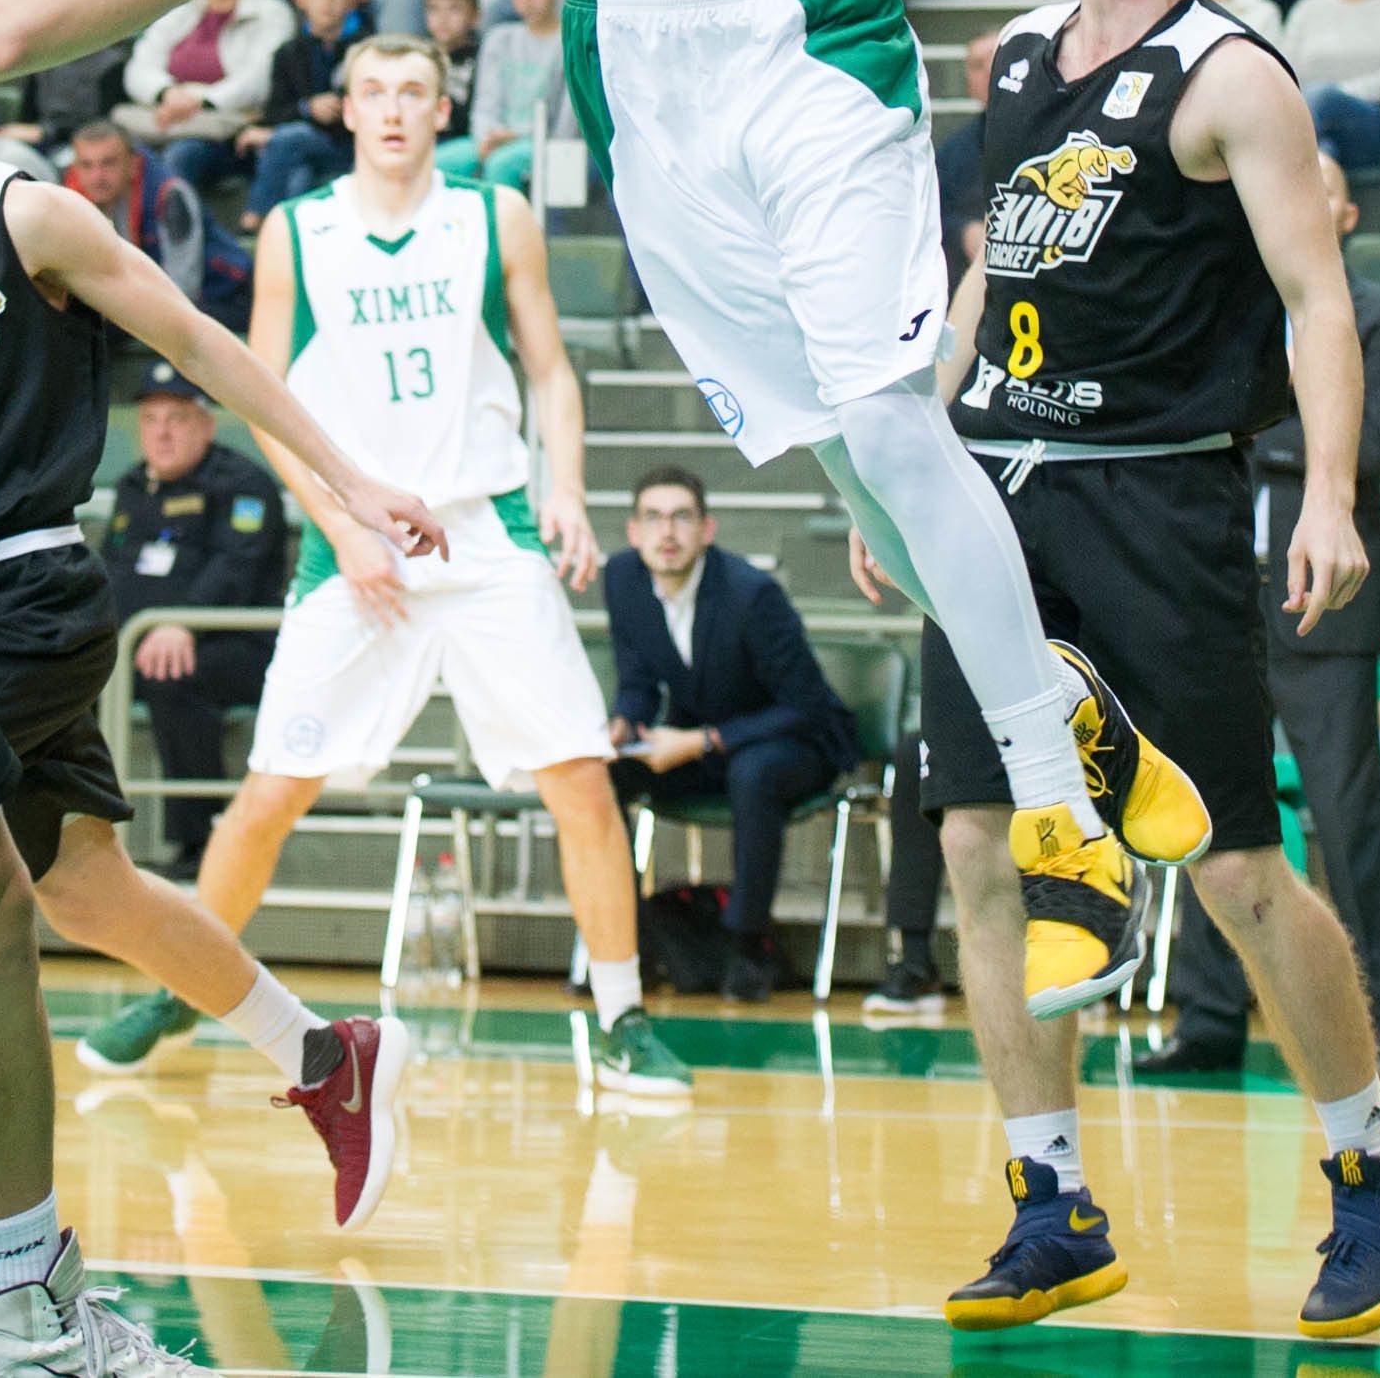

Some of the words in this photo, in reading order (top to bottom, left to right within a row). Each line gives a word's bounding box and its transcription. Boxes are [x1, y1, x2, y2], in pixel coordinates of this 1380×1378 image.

[1007, 301, 1044, 379] 8
[383, 346, 435, 402] 13
[1006, 394, 1082, 426] HOLDING
